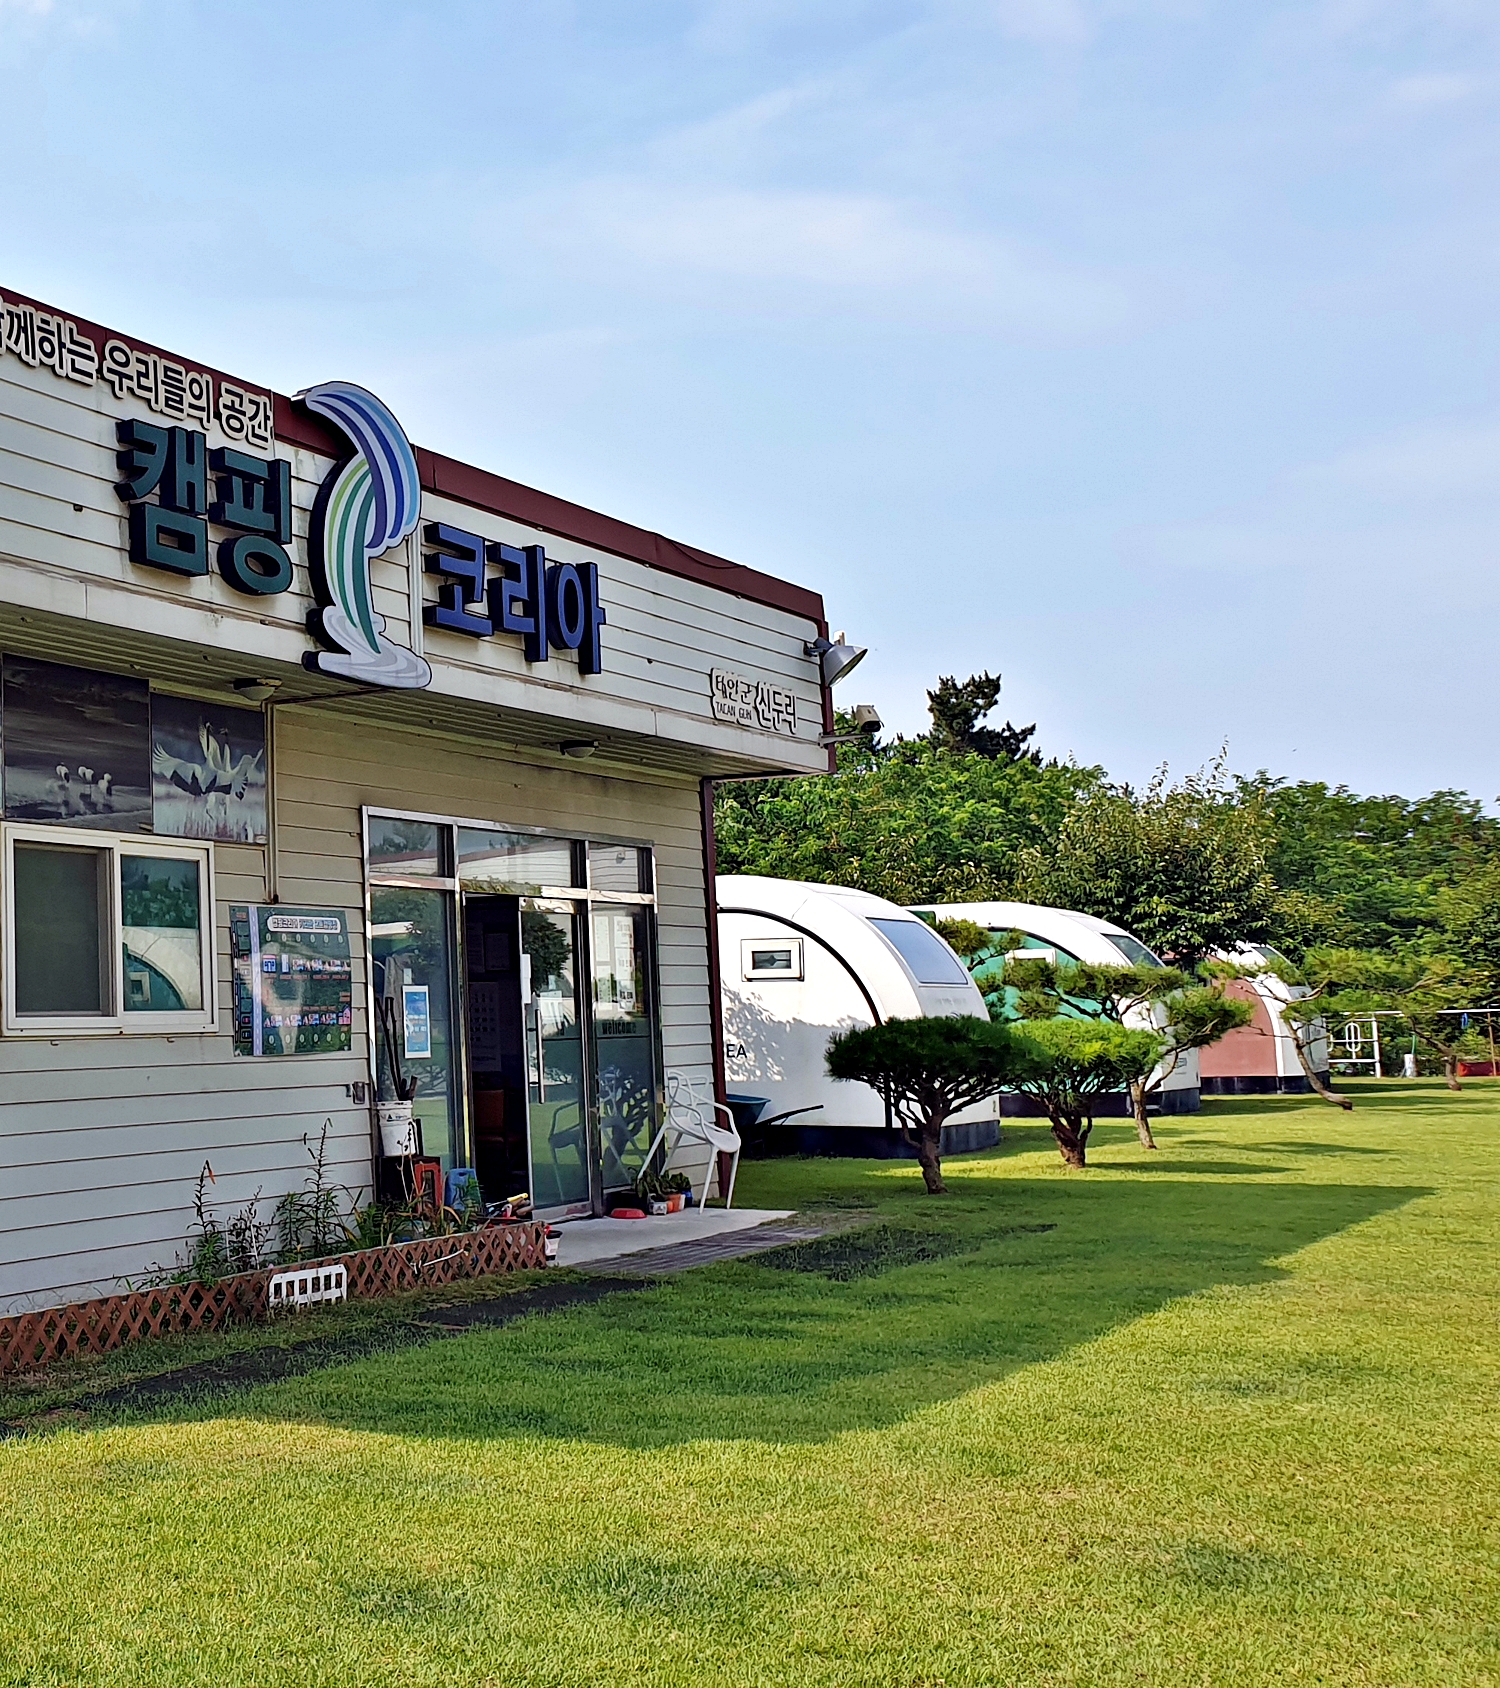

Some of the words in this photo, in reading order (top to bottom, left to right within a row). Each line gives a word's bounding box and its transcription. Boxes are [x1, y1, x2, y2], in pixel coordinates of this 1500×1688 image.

[105, 344, 211, 427] 우리들의
[221, 384, 273, 443] 공간
[115, 418, 293, 596] 캠핑
[423, 522, 605, 675] 코리아
[715, 674, 752, 705] 태안군
[758, 684, 798, 729] 신두리
[726, 1043, 748, 1058] EA
